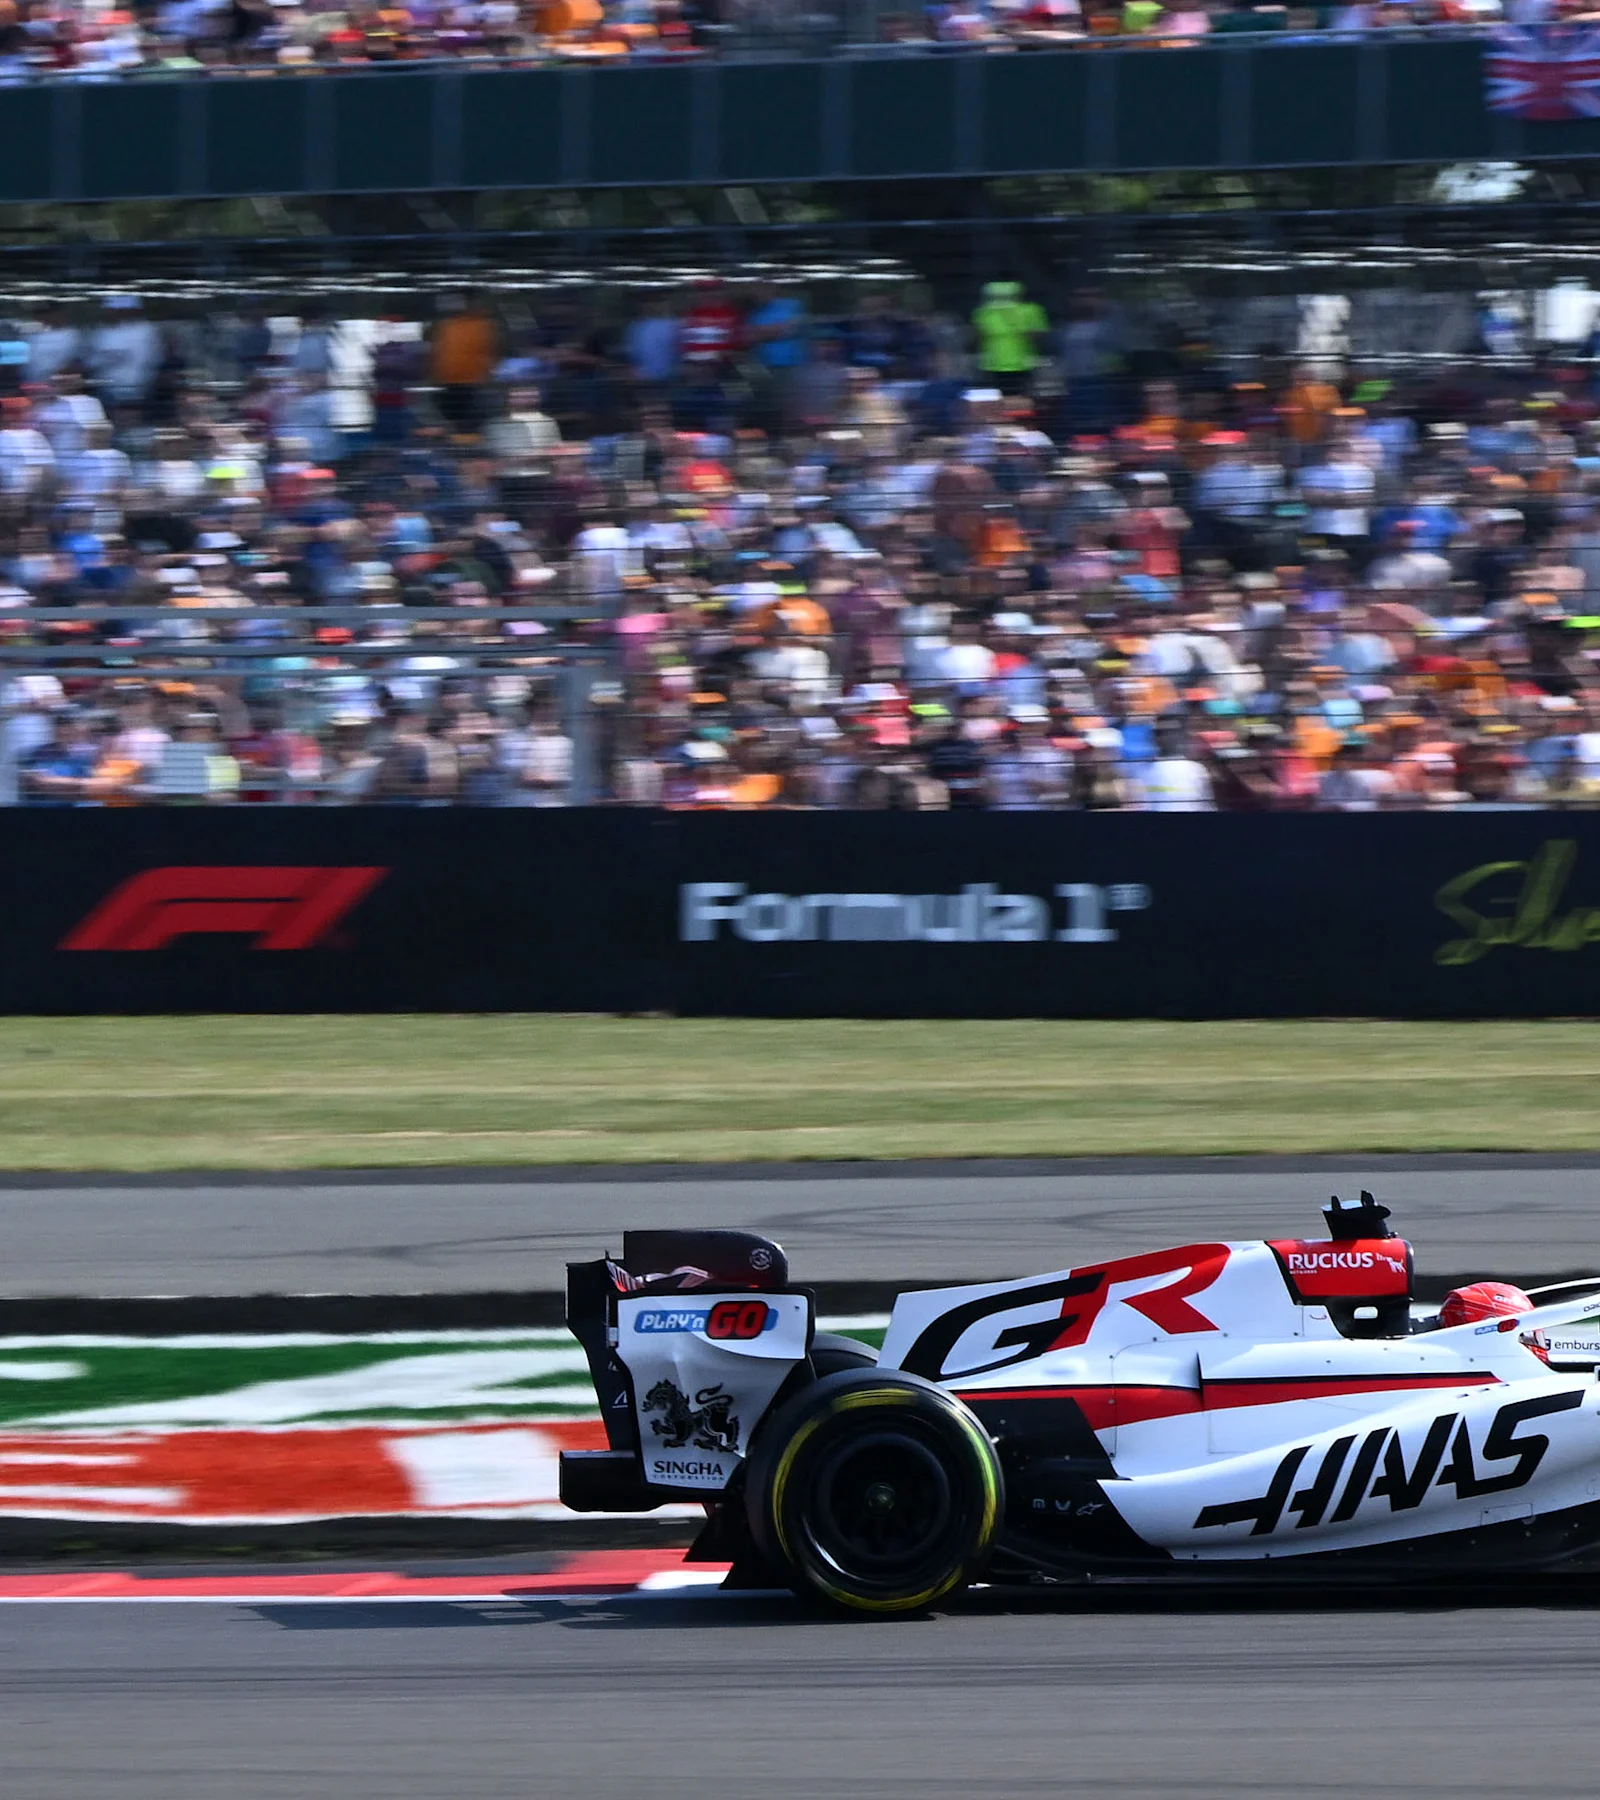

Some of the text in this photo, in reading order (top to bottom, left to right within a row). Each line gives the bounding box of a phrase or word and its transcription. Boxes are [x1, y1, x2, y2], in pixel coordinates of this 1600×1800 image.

[678, 882, 1048, 942] Formula
[1288, 1252, 1375, 1270] RUCKUS
[707, 1302, 767, 1338] GO
[899, 1243, 1231, 1383] GR
[653, 1461, 723, 1475] SINGHA
[1193, 1390, 1586, 1536] HAAS
